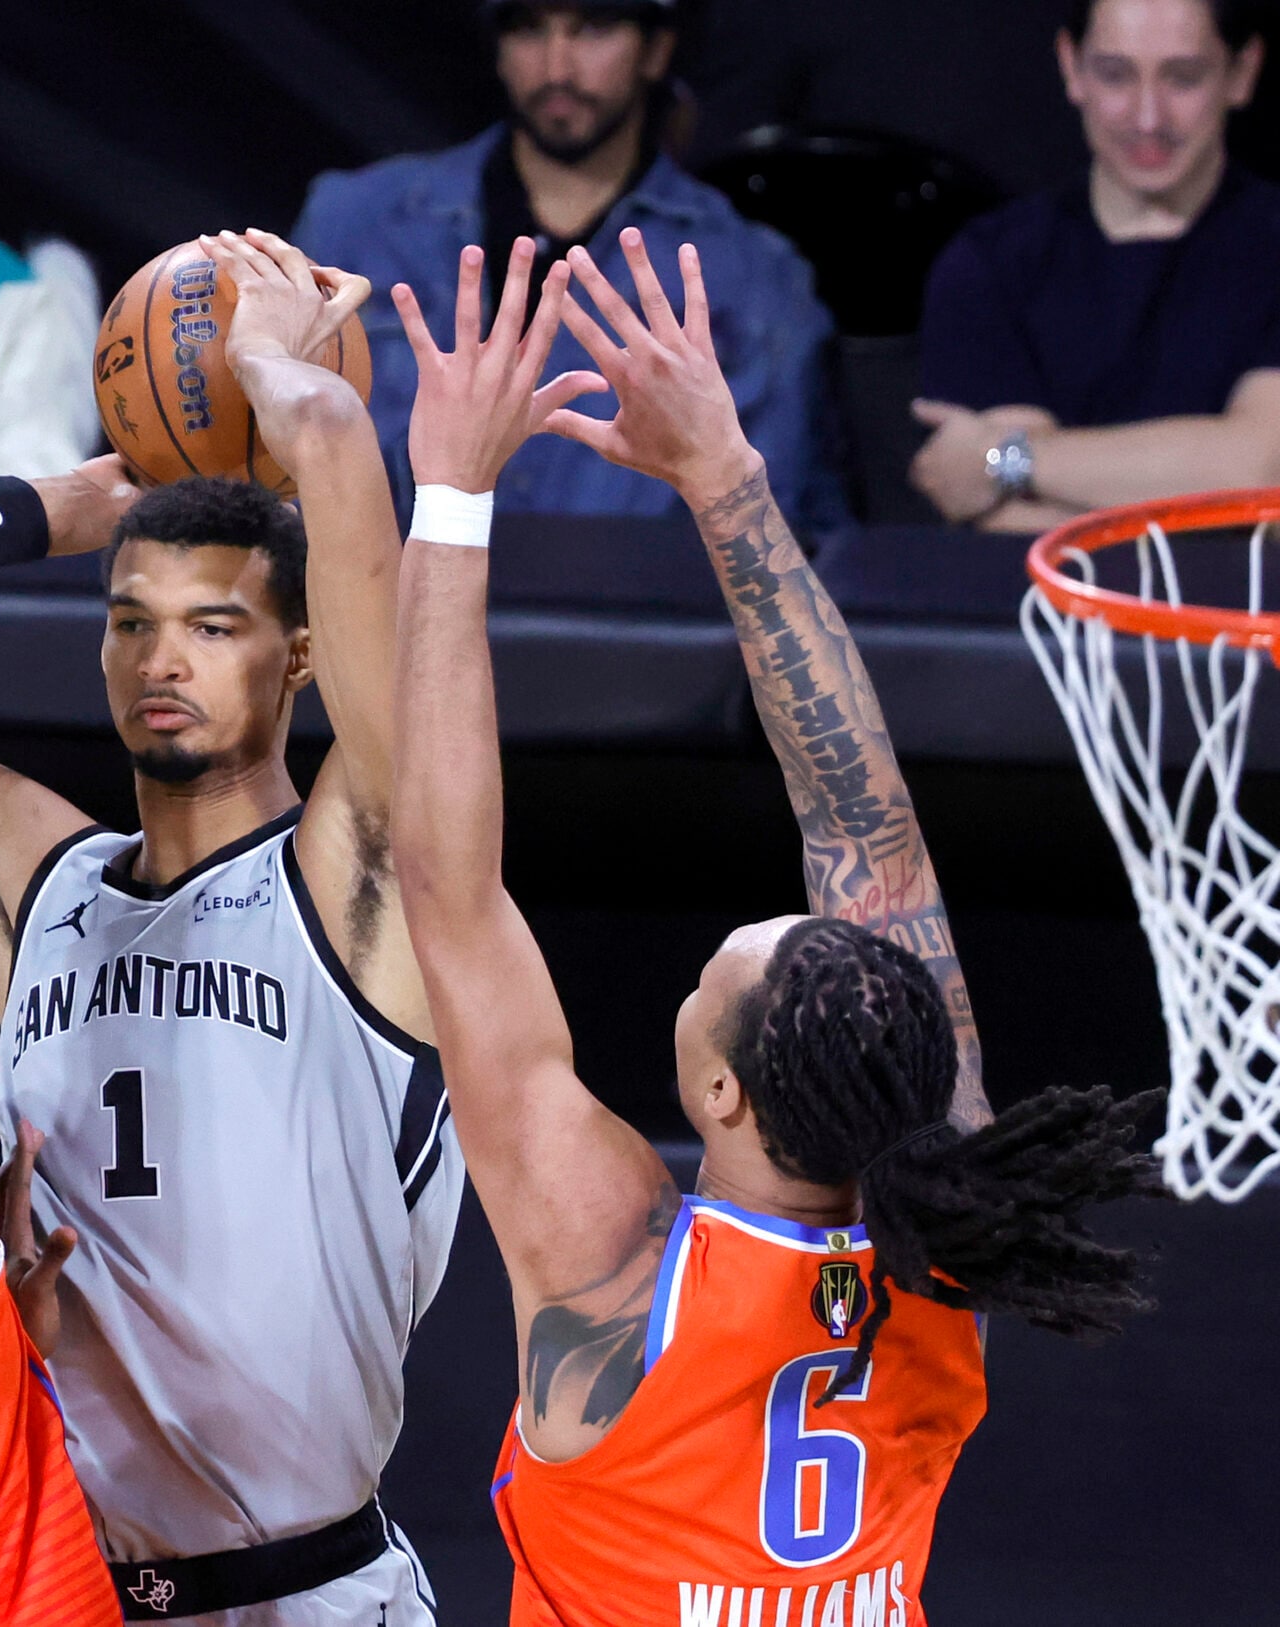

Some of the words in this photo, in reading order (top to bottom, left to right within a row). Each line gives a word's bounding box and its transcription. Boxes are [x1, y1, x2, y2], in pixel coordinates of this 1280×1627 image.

[170, 257, 218, 434] Wilson
[716, 531, 894, 838] SACRIFICE
[203, 889, 261, 912] LEDGER
[11, 967, 79, 1072] SAN
[81, 951, 289, 1045] ANTONIO
[100, 1067, 161, 1202] 1
[759, 1347, 873, 1568] 6
